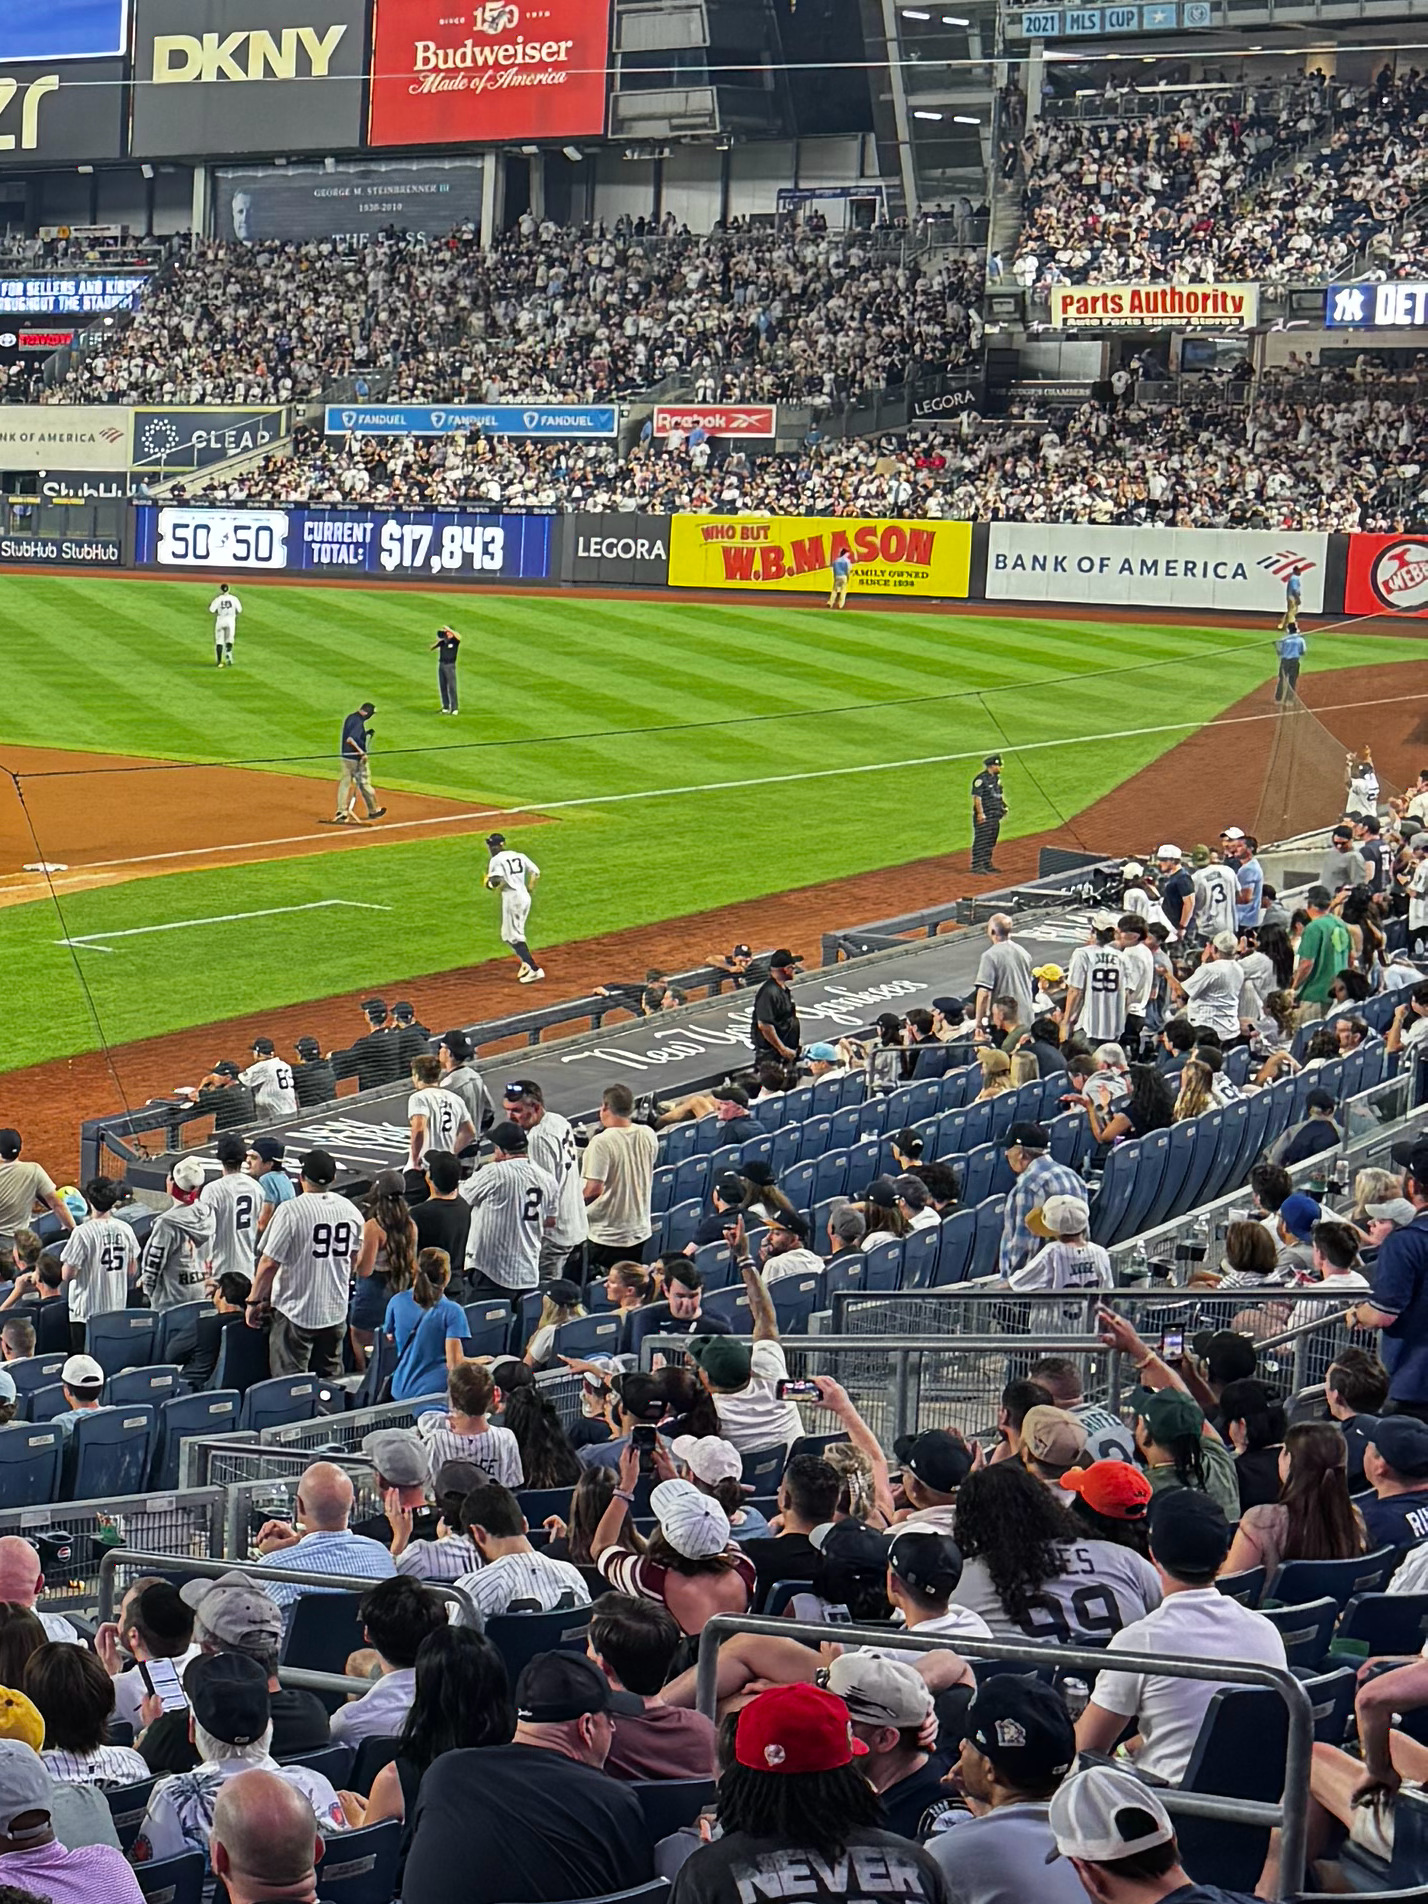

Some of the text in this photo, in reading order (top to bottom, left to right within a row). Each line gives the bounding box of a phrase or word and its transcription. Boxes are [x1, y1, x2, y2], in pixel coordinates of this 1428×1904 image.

[1025, 9, 1135, 34] 2021 MLS CUP
[153, 24, 347, 84] DKNY
[413, 35, 574, 71] Budweiser
[408, 67, 568, 95] Made of America
[1061, 285, 1245, 315] Parts Authority
[915, 390, 975, 416] LEGORA
[357, 414, 407, 426] FANDUEL
[541, 415, 594, 427] FANDUEL
[19, 432, 35, 442] OF
[38, 433, 96, 443] AMERICA
[171, 524, 273, 561] 50 50
[304, 521, 373, 543] CURRENT
[701, 525, 771, 541] WHO BUT
[1, 541, 57, 558] StubHub
[62, 543, 118, 560] StubHub
[312, 542, 364, 565] TOTAL:
[380, 519, 504, 574] $17,843
[578, 537, 667, 560] LEGORA
[995, 553, 1248, 580] BANK OF AMERICA
[507, 858, 523, 875] 13
[1212, 884, 1226, 904] 3
[1093, 968, 1119, 992] 99
[562, 1028, 705, 1070] New
[236, 1195, 251, 1228] 2
[524, 1188, 542, 1221] 2
[313, 1224, 350, 1257] 99
[101, 1246, 125, 1271] 45
[729, 1847, 925, 1904] NEVER
